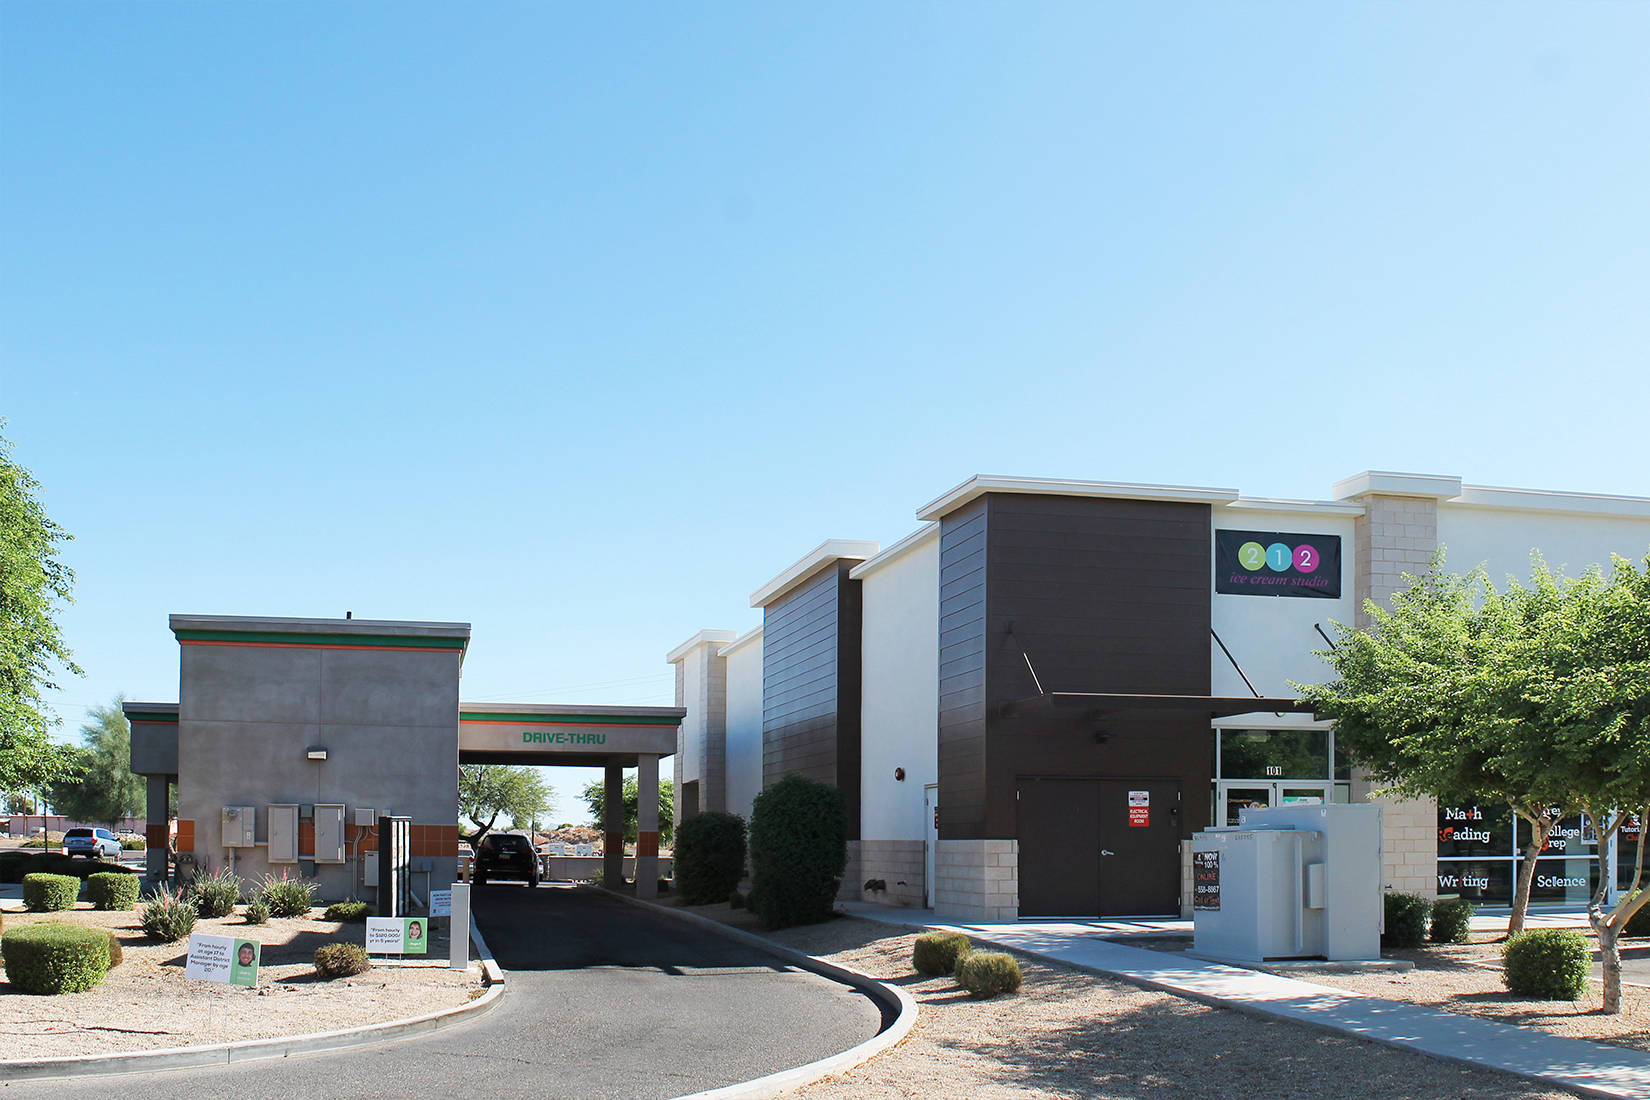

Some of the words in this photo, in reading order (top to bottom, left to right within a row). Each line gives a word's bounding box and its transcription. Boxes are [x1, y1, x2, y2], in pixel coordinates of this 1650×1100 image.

[1230, 573, 1248, 584] ice
[1250, 576, 1288, 585] cream
[1290, 575, 1329, 587] studio
[523, 732, 607, 745] DRIVE-THRU
[1266, 766, 1282, 776] 101
[1548, 825, 1580, 839] ollege
[1204, 852, 1218, 861] NOW
[1537, 875, 1586, 888] Science
[191, 959, 213, 967] Manager
